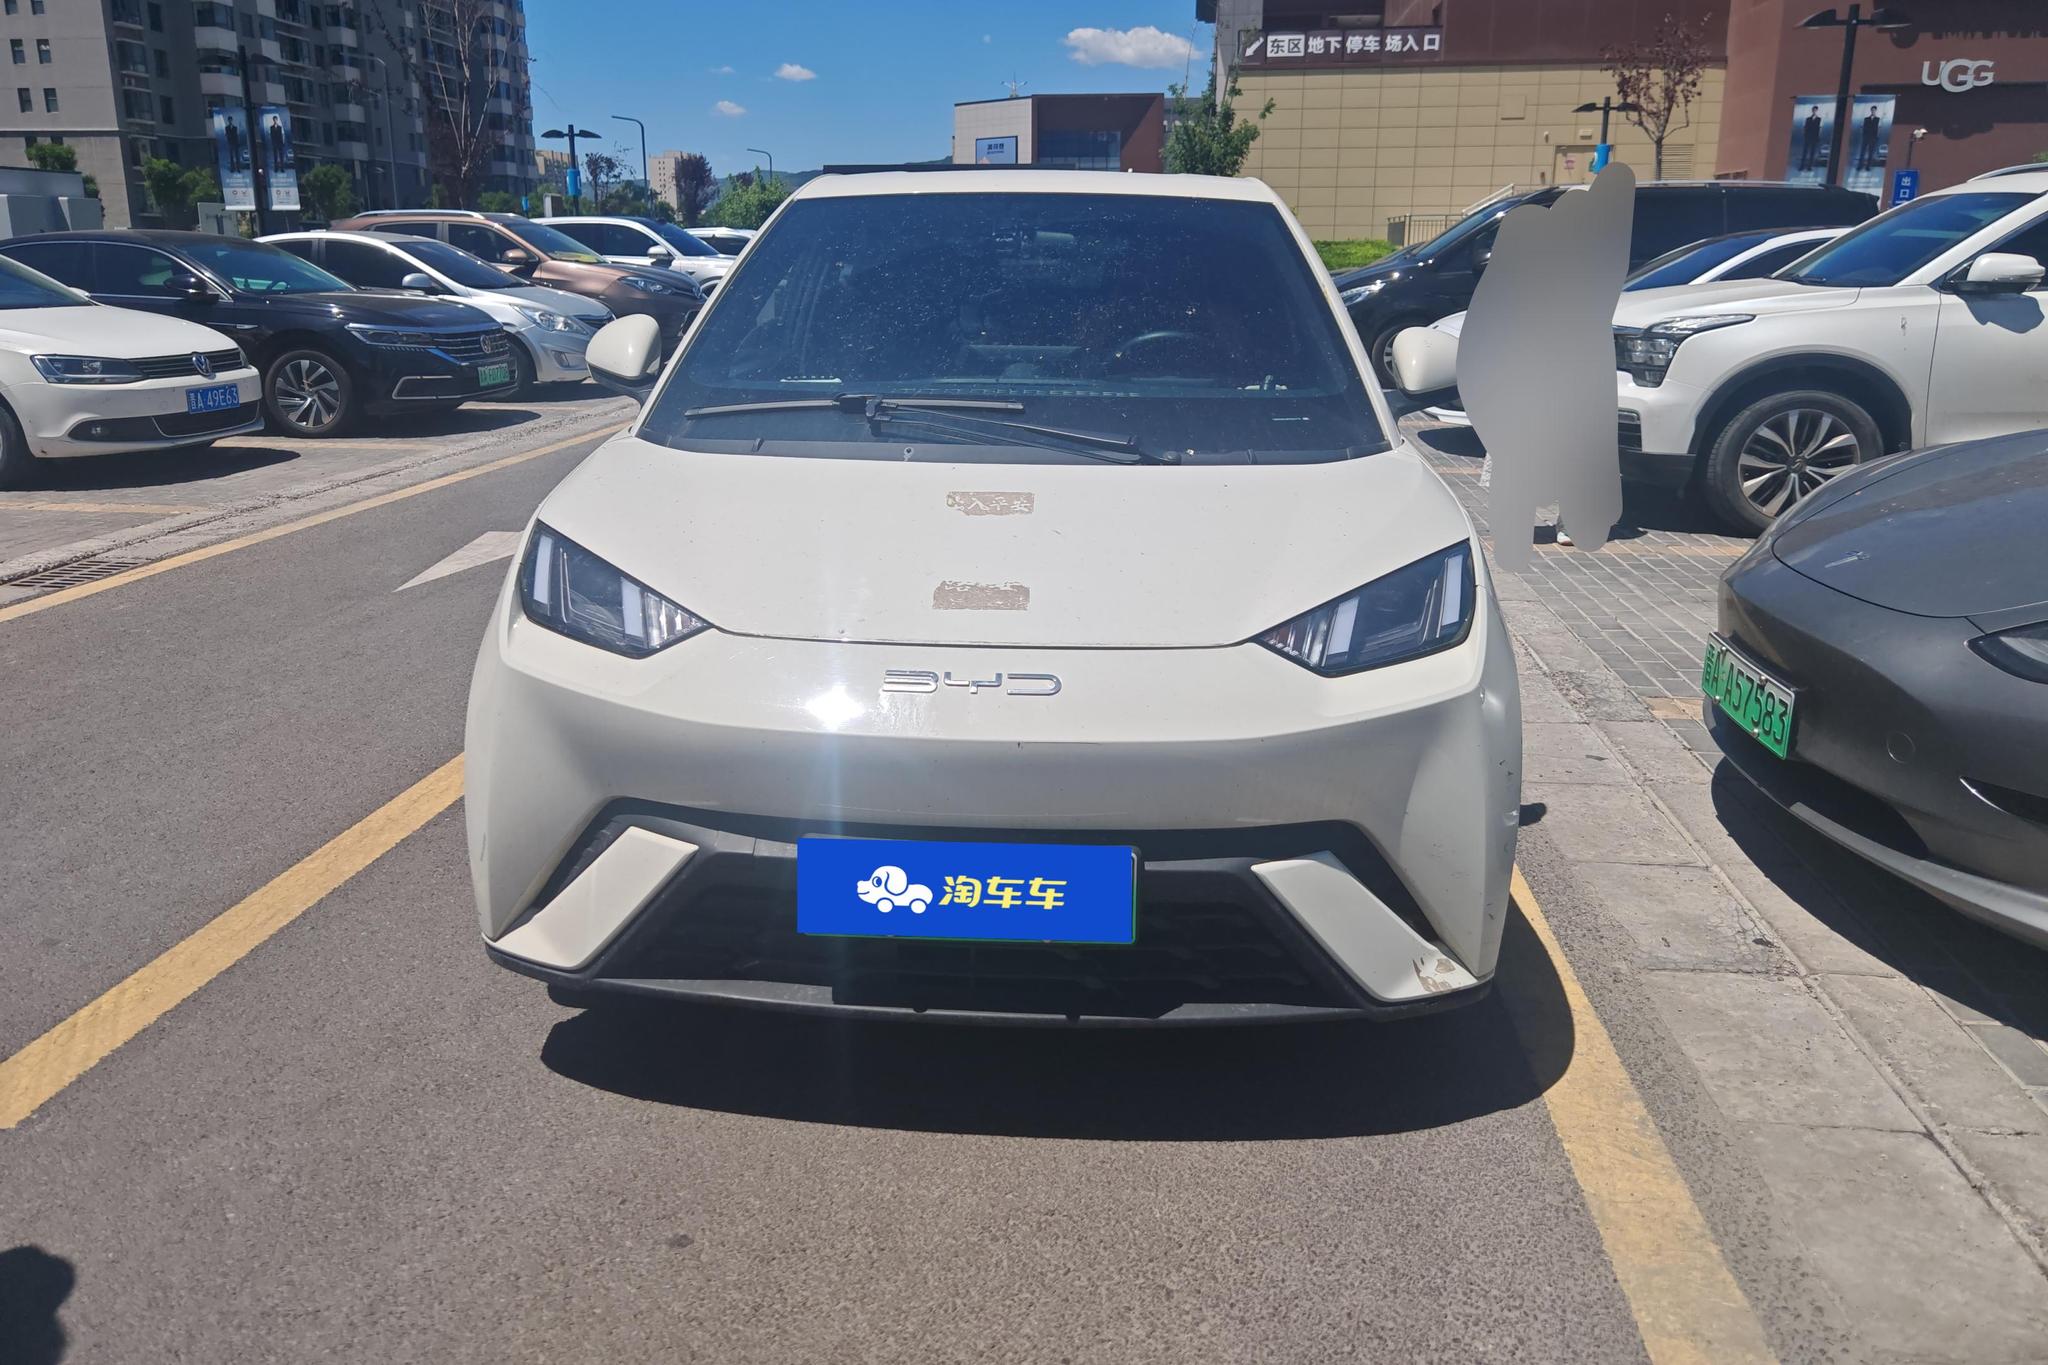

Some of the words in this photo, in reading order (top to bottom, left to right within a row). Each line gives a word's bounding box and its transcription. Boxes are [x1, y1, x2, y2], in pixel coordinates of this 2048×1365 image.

[1922, 59, 1995, 92] UGG
[1900, 176, 1912, 198] 出口
[882, 669, 1062, 696] BYD
